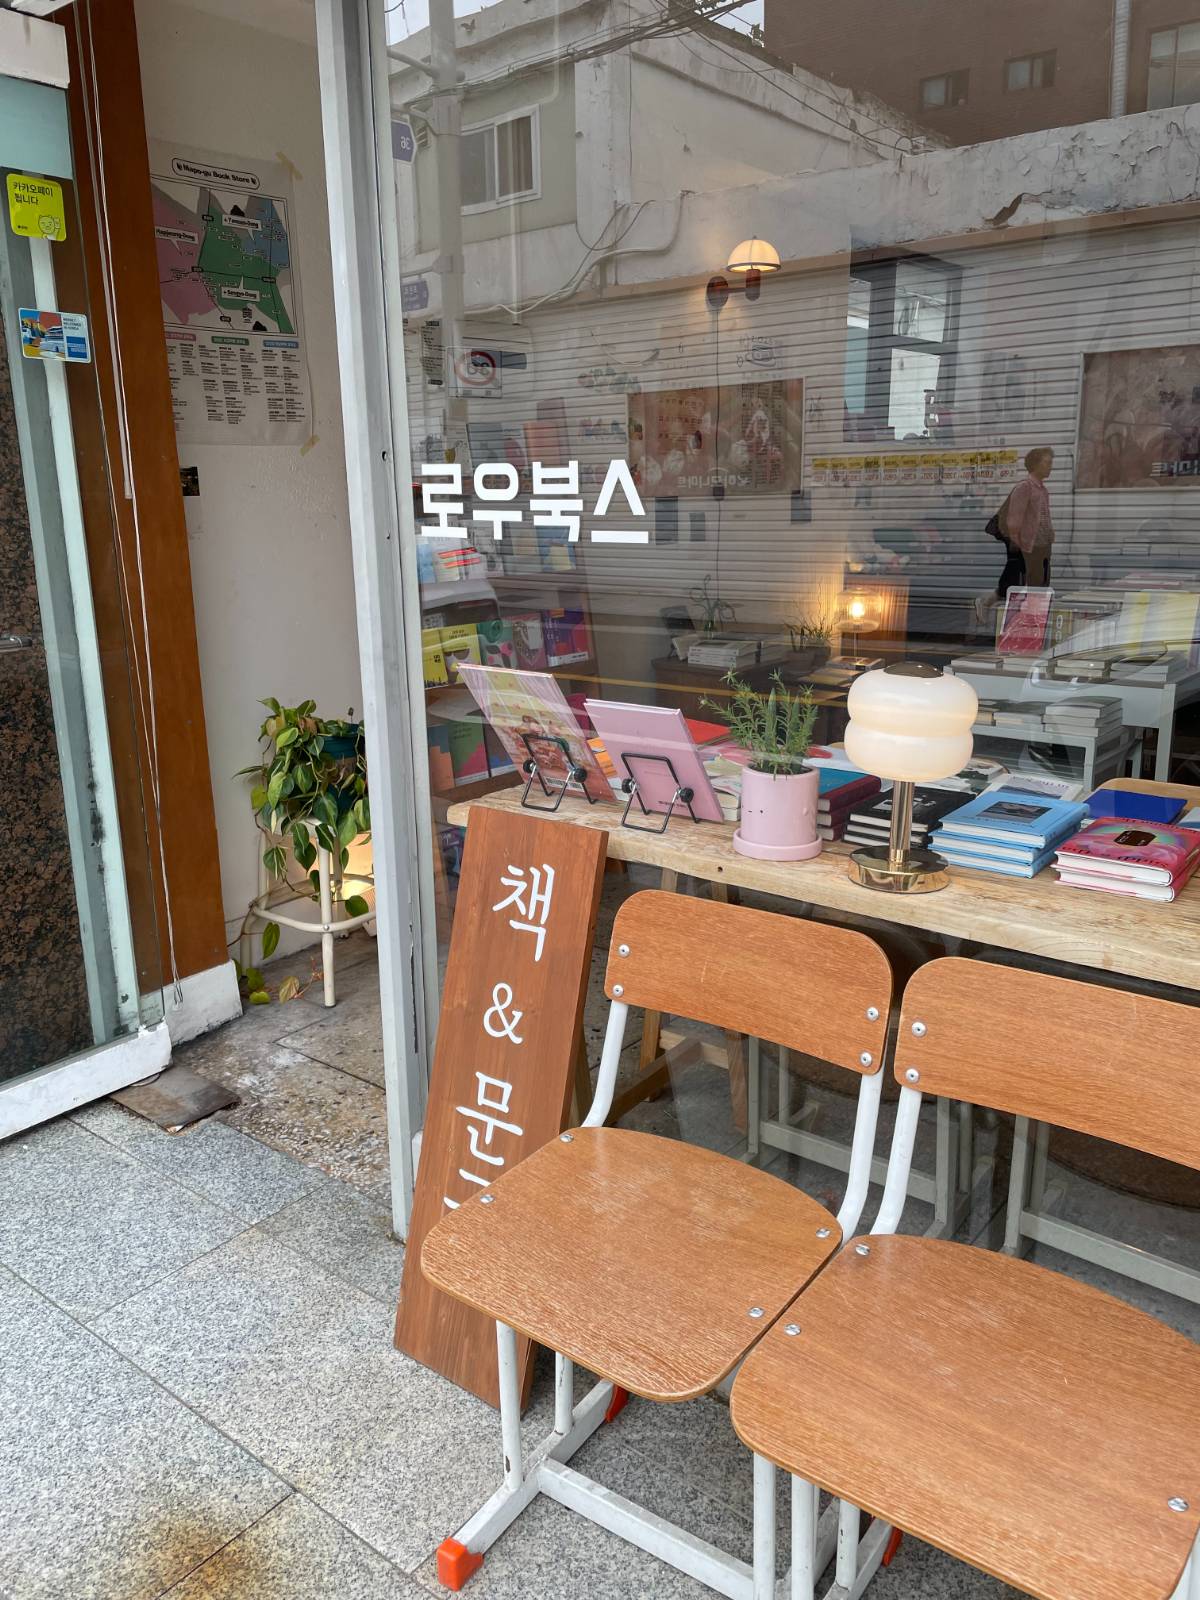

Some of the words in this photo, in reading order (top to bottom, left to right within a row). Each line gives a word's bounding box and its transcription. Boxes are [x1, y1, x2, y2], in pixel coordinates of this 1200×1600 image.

[13, 182, 53, 197] 카카오페이
[212, 170, 230, 180] Book
[231, 174, 250, 184] Store
[421, 459, 649, 544] 로우북스
[492, 863, 555, 962] 책
[483, 982, 524, 1044] &
